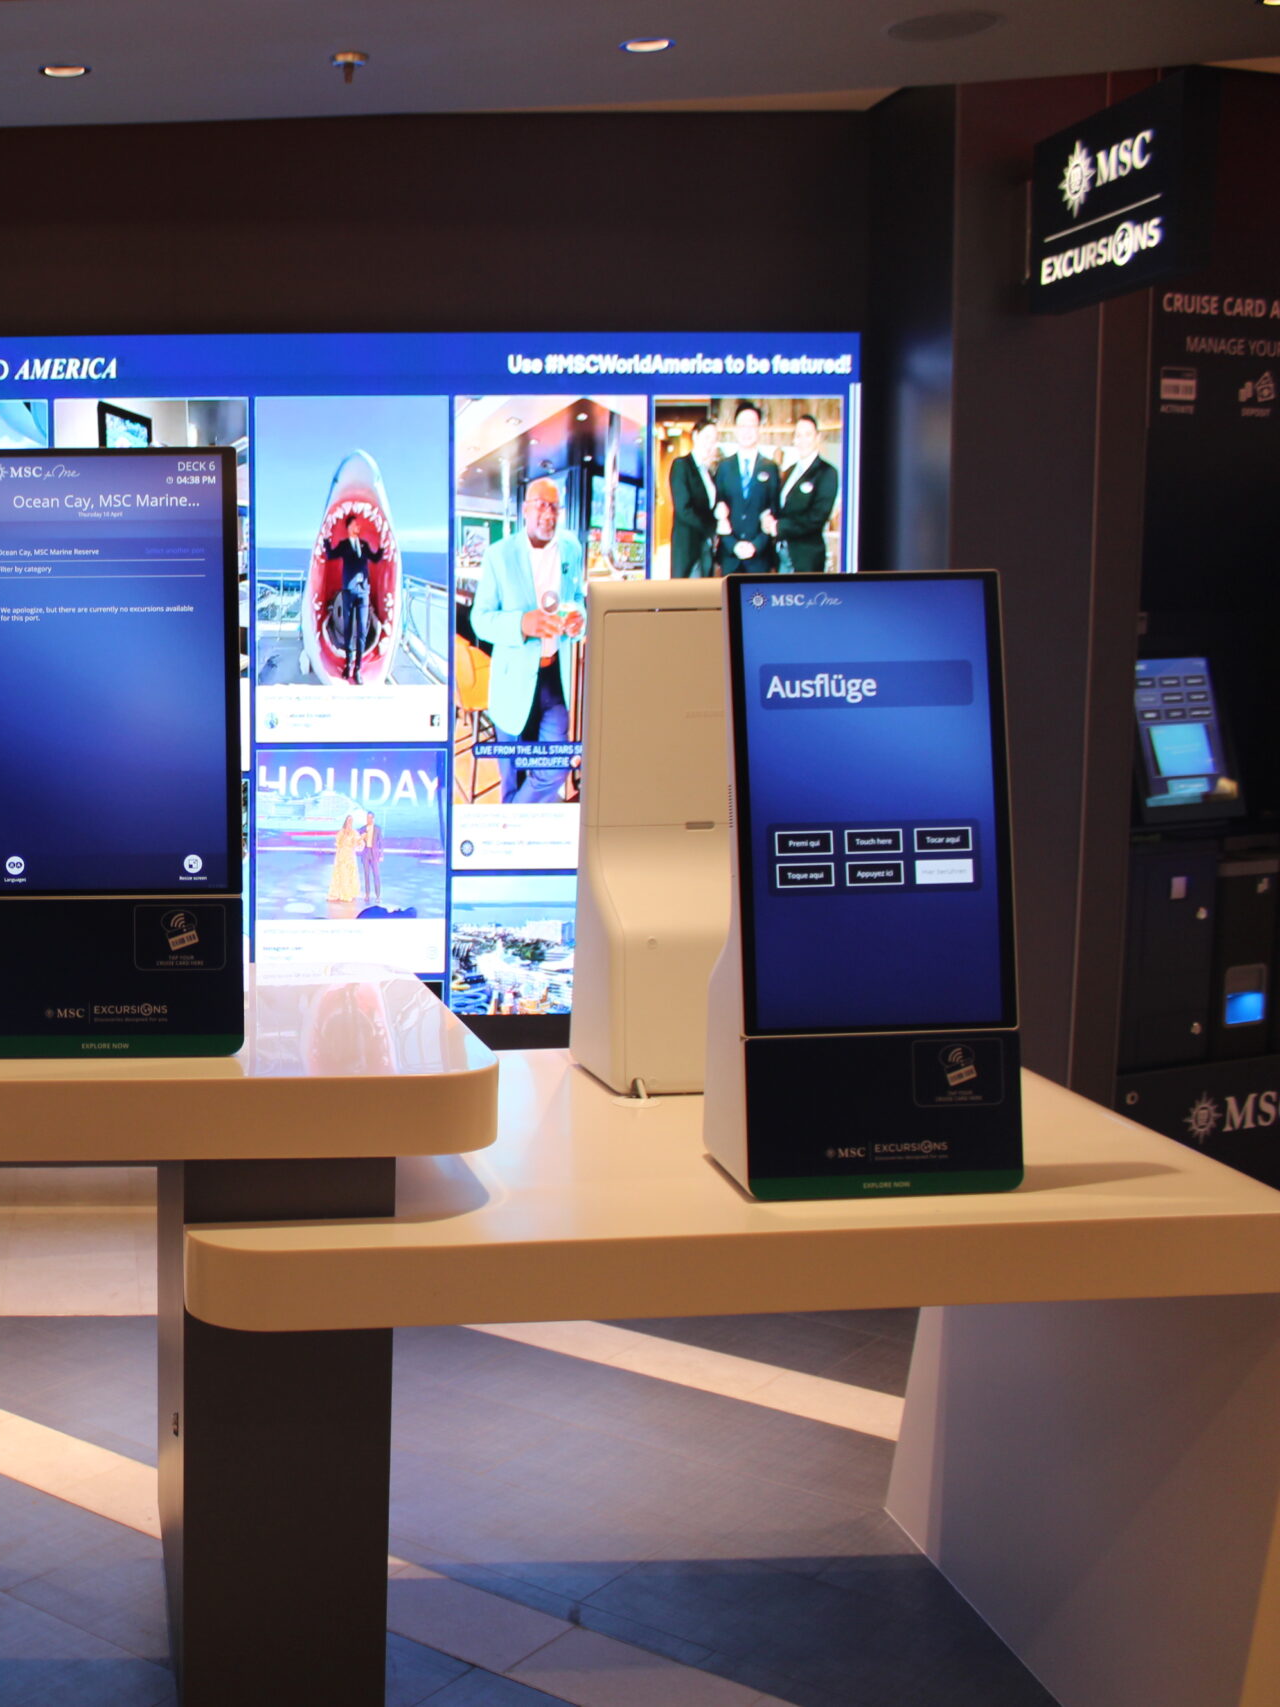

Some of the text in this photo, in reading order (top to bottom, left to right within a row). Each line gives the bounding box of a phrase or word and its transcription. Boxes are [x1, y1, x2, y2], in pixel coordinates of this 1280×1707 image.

[1095, 129, 1153, 187] MSC
[1040, 217, 1163, 286] EXCURSIONS
[1162, 292, 1219, 315] CRUISE
[1223, 296, 1267, 318] CARD
[1186, 335, 1245, 356] MANAGE
[14, 357, 117, 380] AMERICA
[508, 354, 851, 374] Use #MSCWorldAmerica to be featured!
[9, 466, 42, 478] MSC
[177, 460, 216, 472] DECK 6
[176, 475, 216, 485] 04:38 PM
[13, 495, 59, 508] Ocean
[64, 495, 94, 511] Cay,
[99, 494, 131, 507] MSC
[34, 548, 48, 556] MSC
[15, 566, 23, 574] by
[24, 566, 52, 574] category
[771, 594, 805, 607] MSC
[89, 606, 119, 614] currently
[766, 673, 877, 703] Ausflüge
[475, 745, 492, 755] LIVE
[493, 745, 515, 755] FROM
[517, 745, 532, 755] THE
[533, 744, 547, 754] ALL
[549, 744, 574, 754] STARS
[788, 839, 820, 849] Premi qui
[856, 837, 892, 846] Touch here
[787, 872, 808, 880] Toque
[856, 870, 882, 879] Appuyez
[56, 1003, 168, 1018] MSC EXCURSIONS
[1222, 1090, 1280, 1132] MS
[837, 1147, 866, 1158] MSC
[874, 1139, 949, 1154] EXCURSIONS
